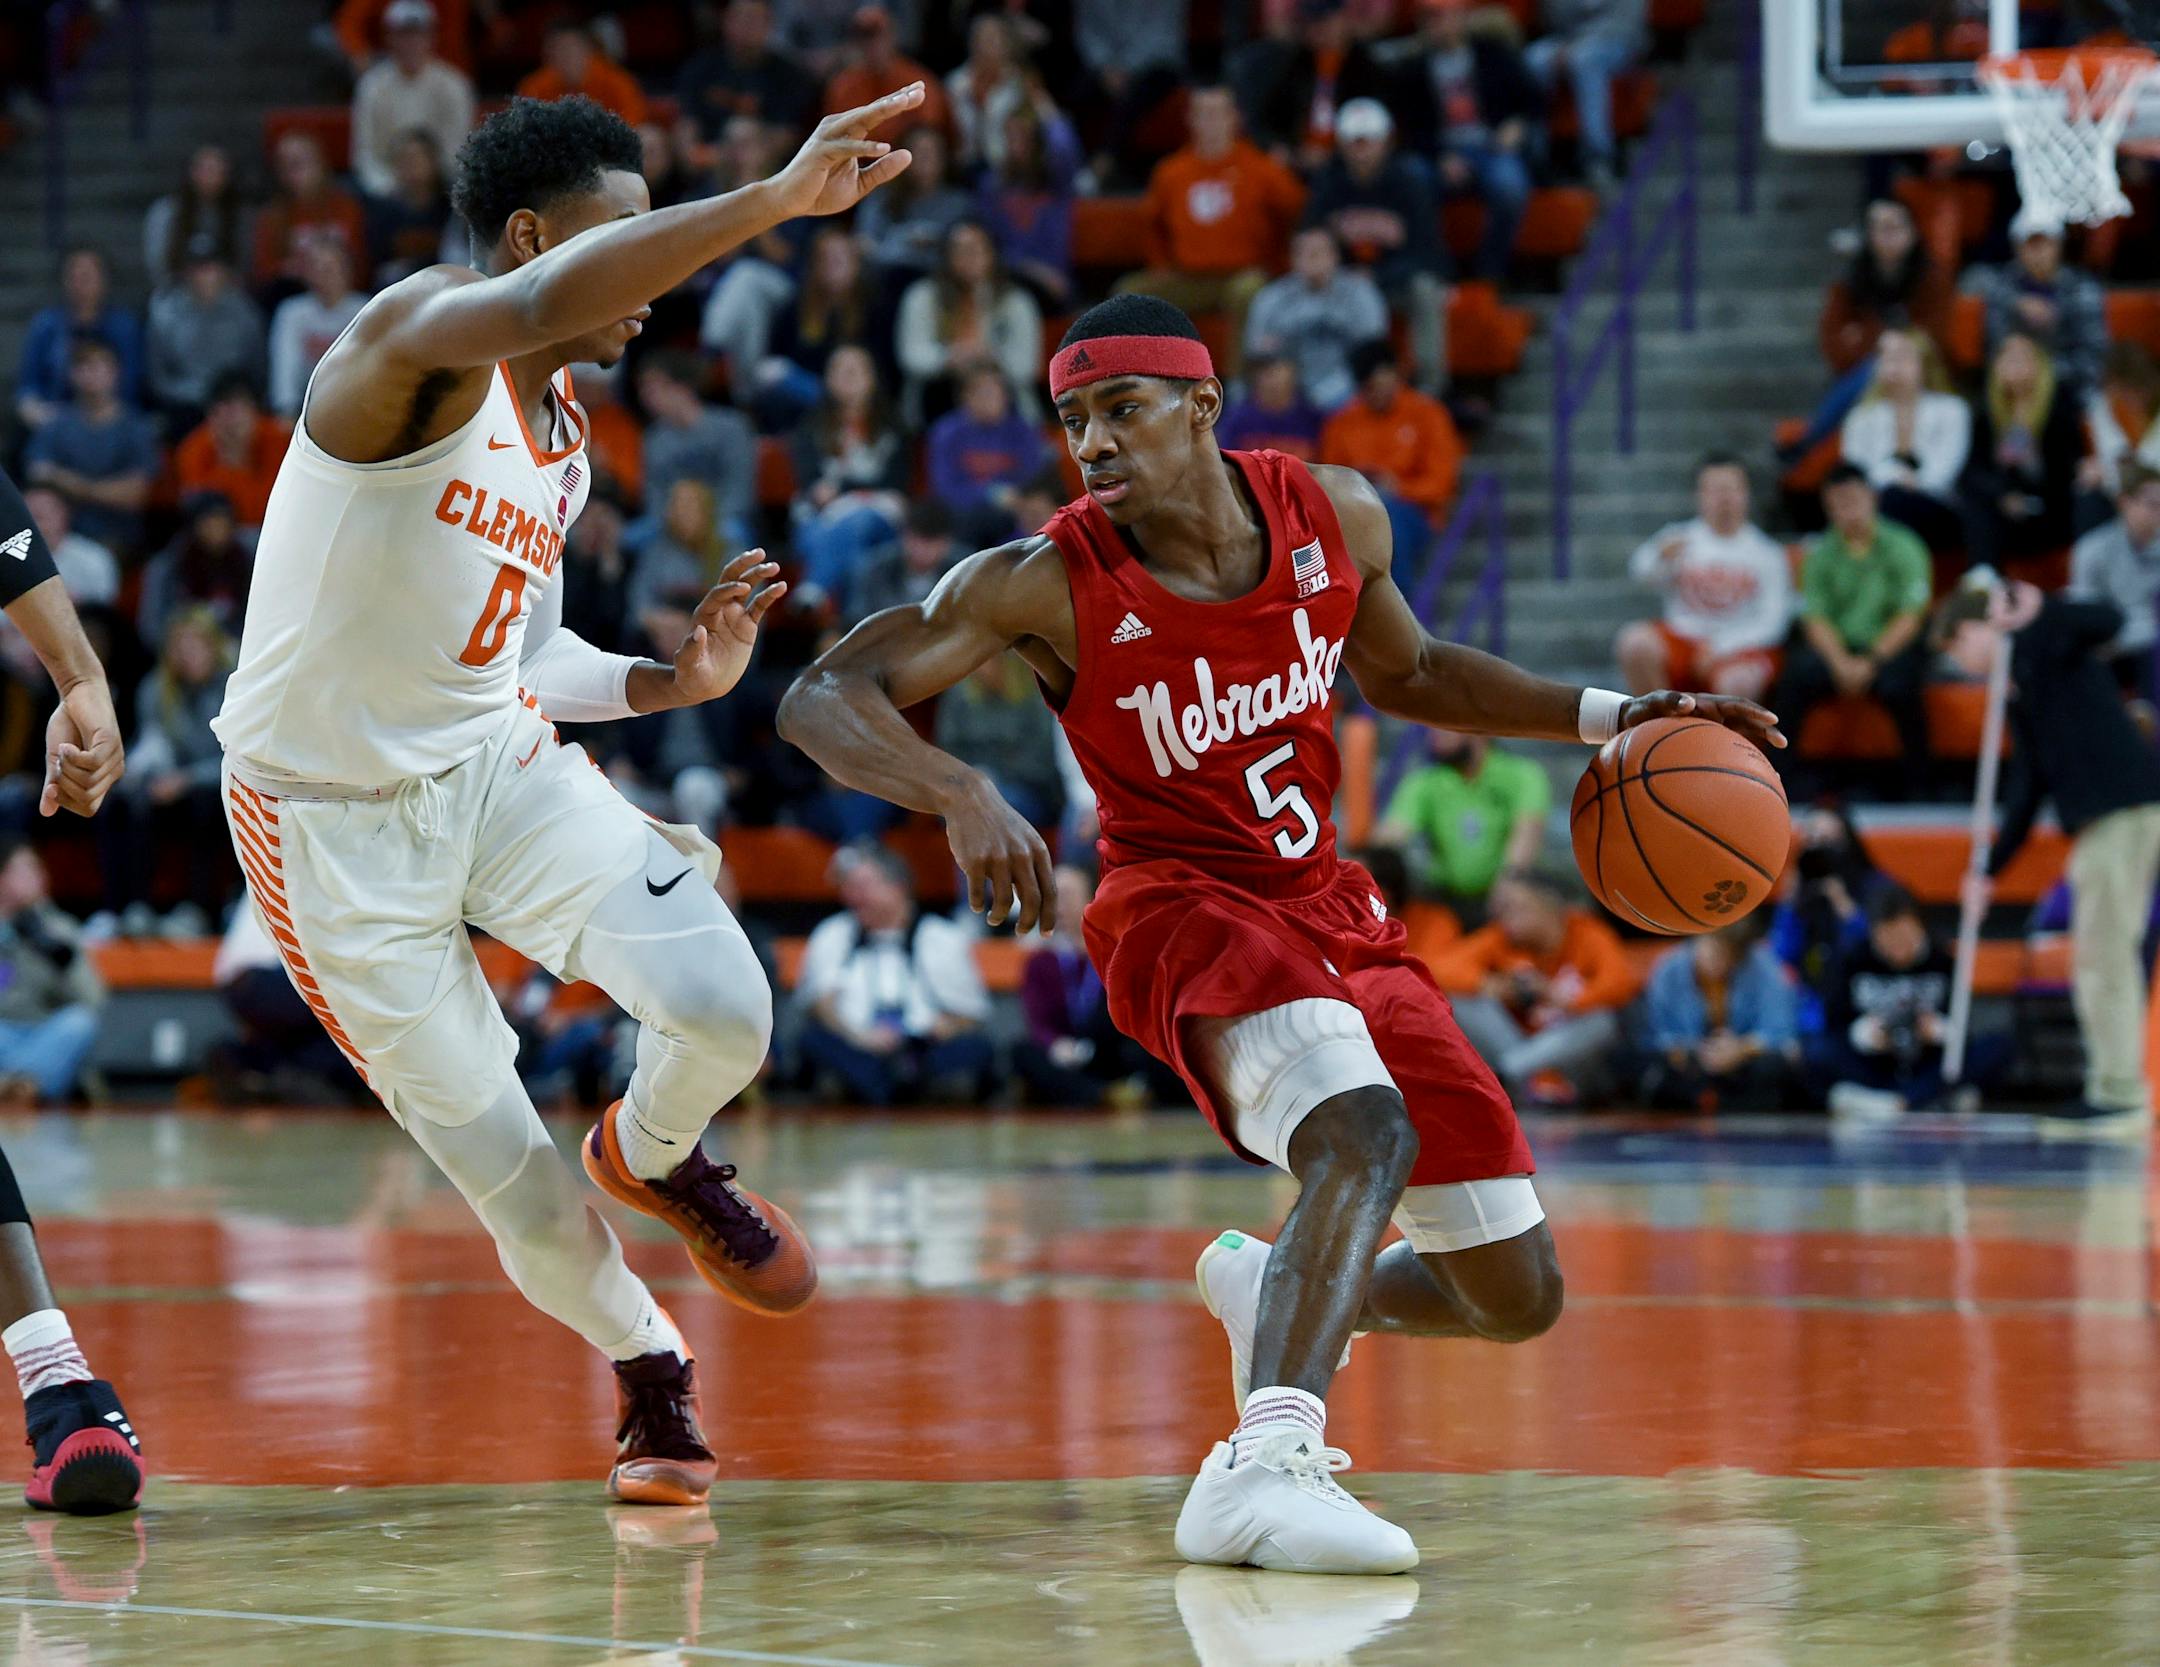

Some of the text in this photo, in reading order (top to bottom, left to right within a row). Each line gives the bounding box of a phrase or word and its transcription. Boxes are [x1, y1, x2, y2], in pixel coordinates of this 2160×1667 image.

[435, 479, 566, 577] CLEMSO
[458, 563, 527, 667] 0
[1111, 627, 1152, 644] adidas
[1116, 607, 1344, 777] Nebraska
[1244, 738, 1320, 858] 5
